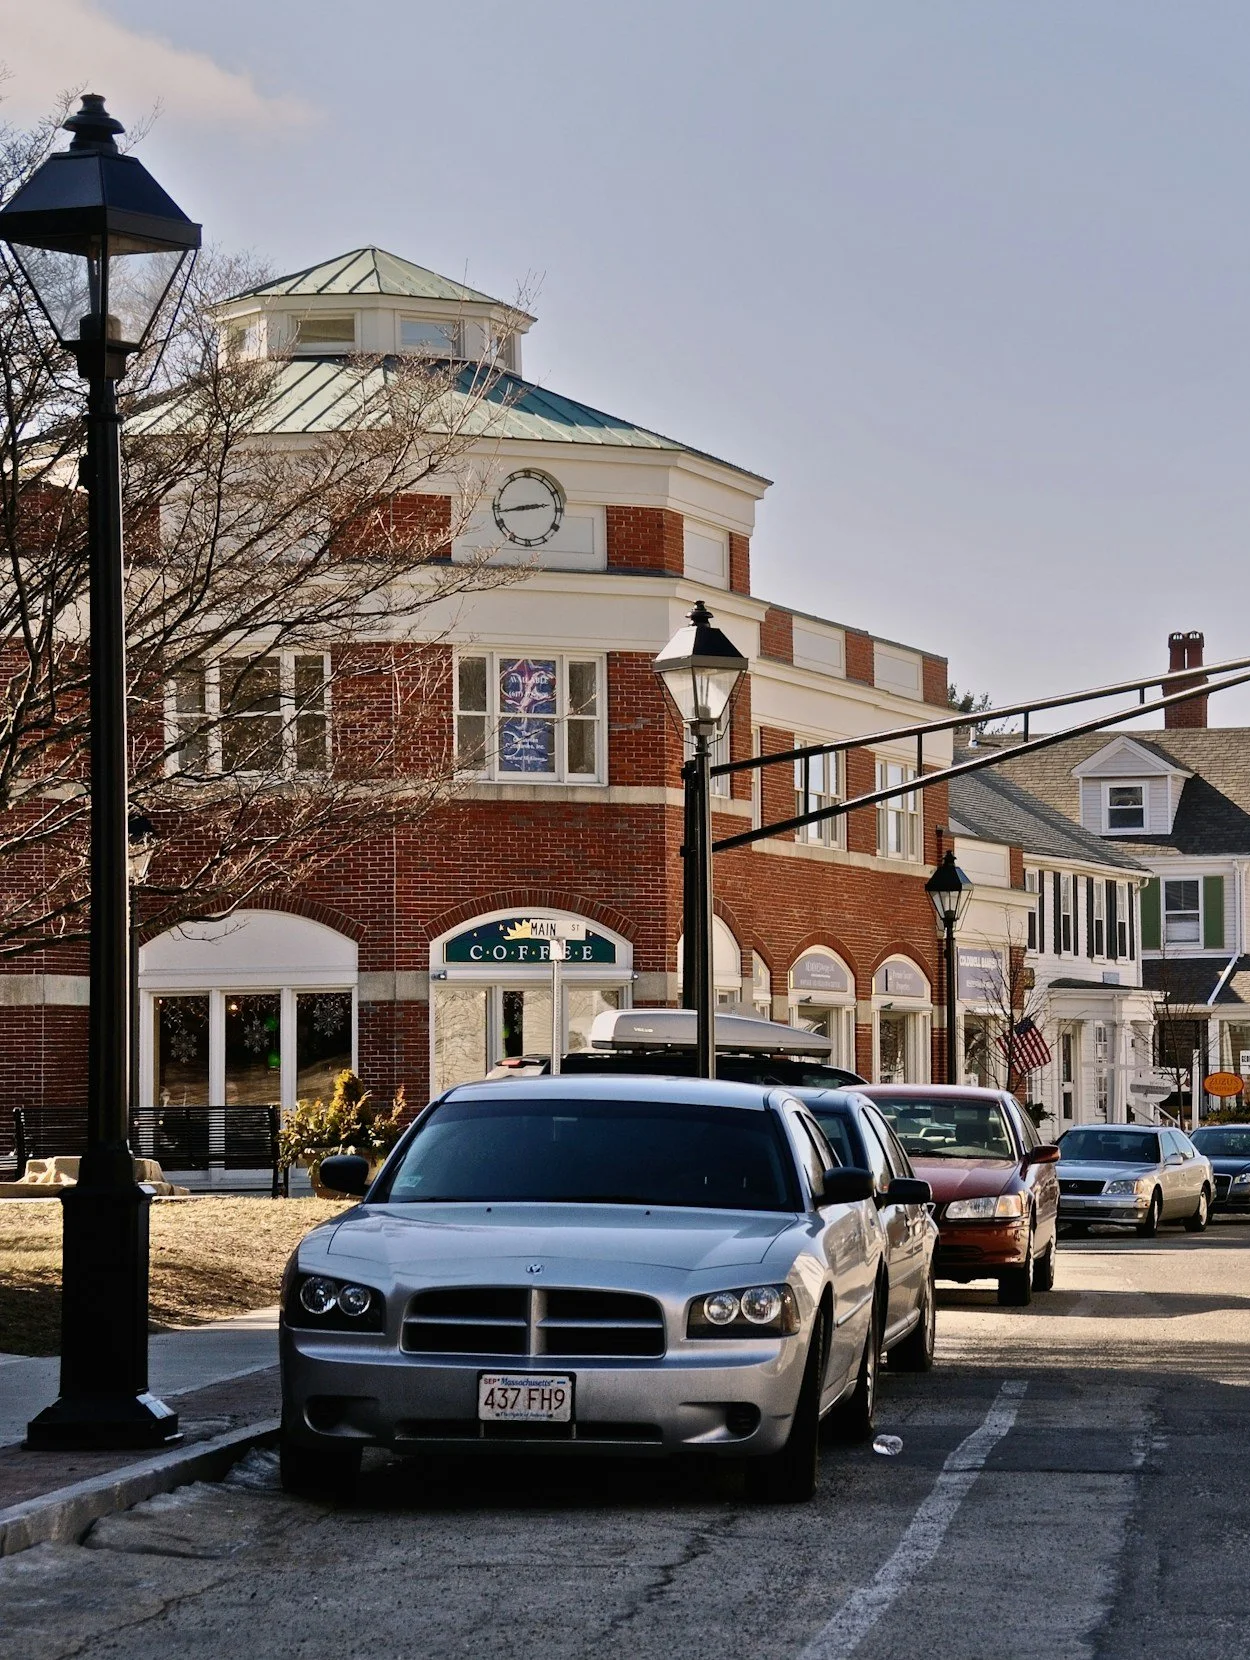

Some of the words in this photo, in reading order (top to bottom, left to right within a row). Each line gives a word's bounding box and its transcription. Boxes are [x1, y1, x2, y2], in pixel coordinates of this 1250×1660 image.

[509, 676, 549, 684] AVILABLE
[530, 922, 557, 936] MAIN
[571, 924, 580, 932] ST
[501, 1377, 551, 1387] Massachusetts
[484, 1388, 521, 1409] 437
[528, 1388, 565, 1410] FH9
